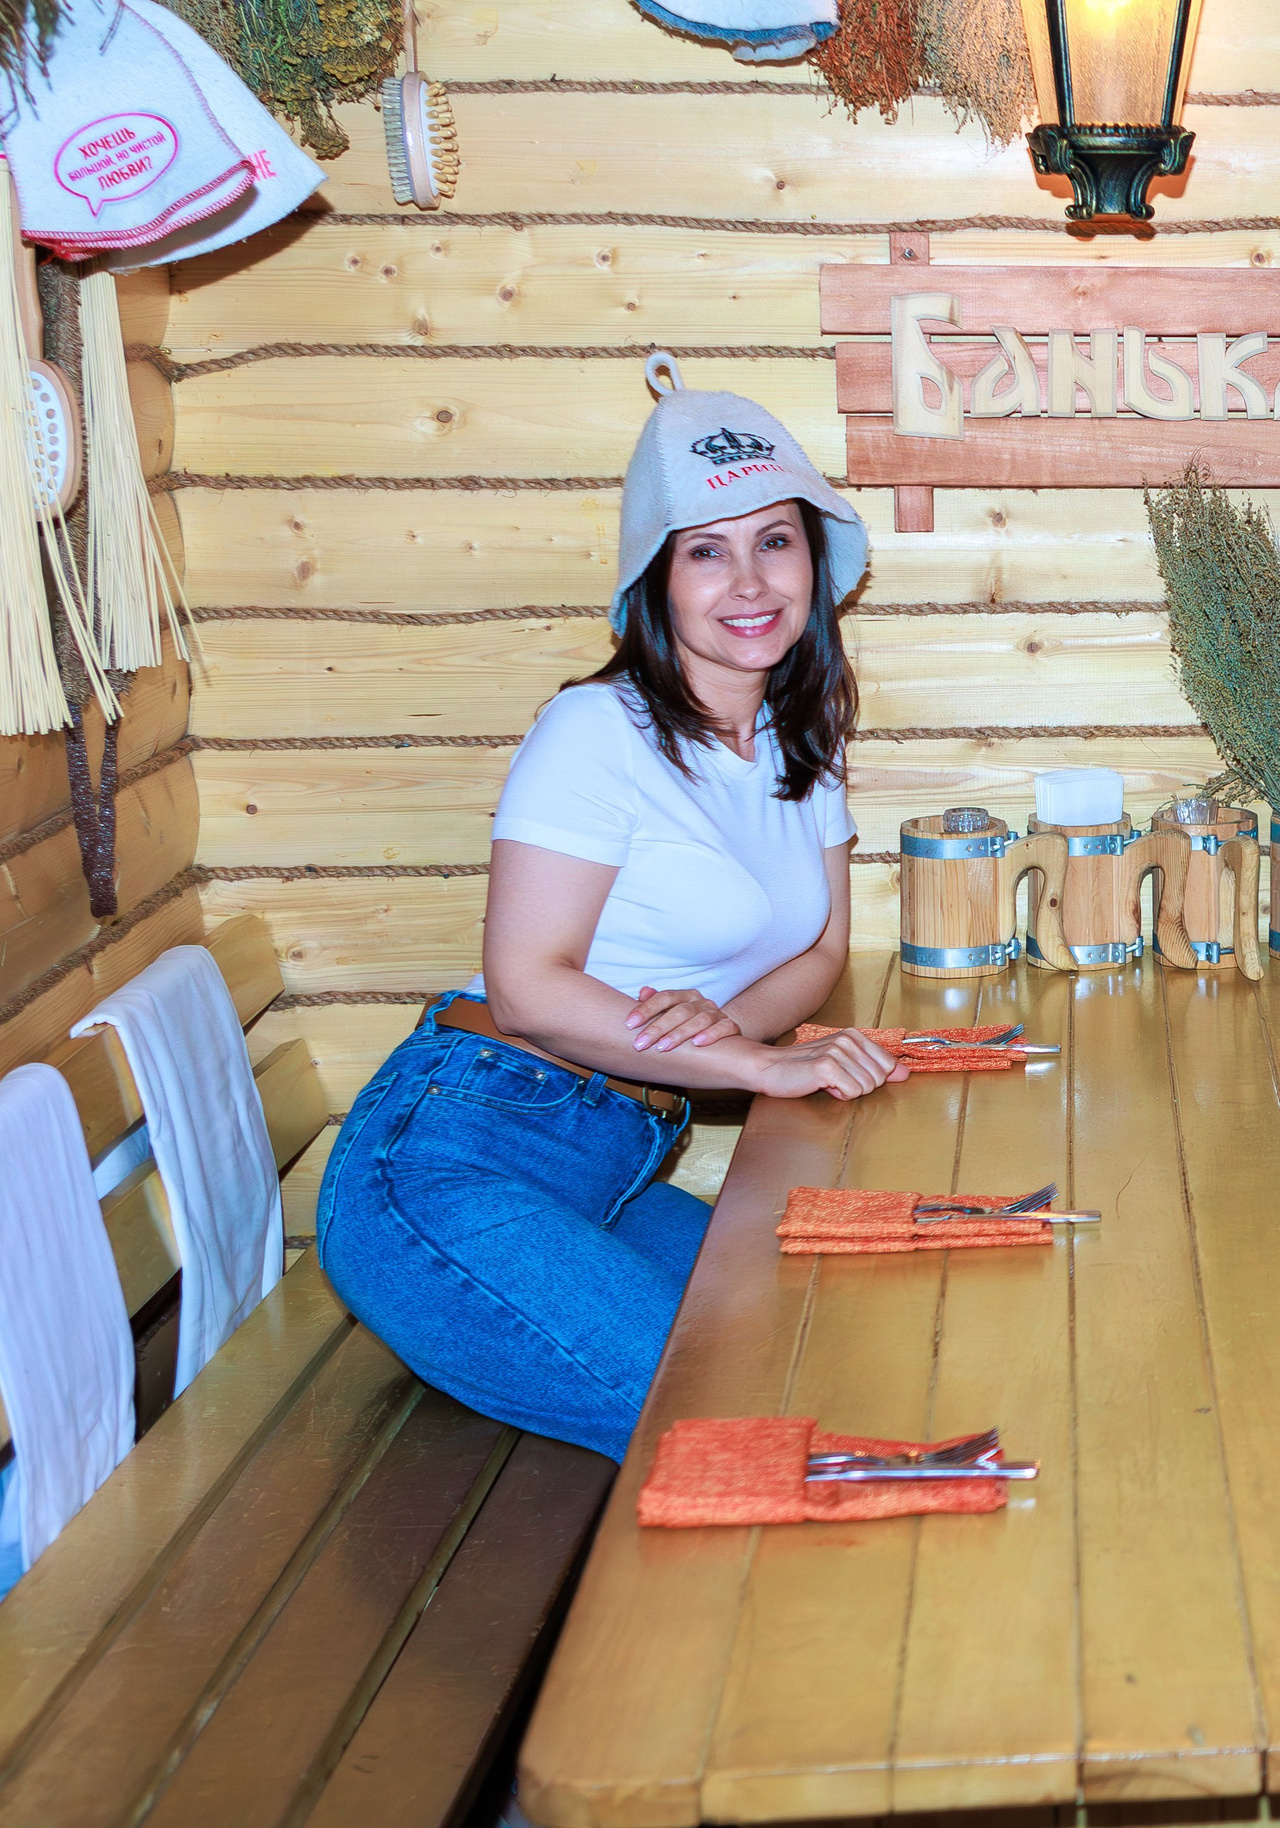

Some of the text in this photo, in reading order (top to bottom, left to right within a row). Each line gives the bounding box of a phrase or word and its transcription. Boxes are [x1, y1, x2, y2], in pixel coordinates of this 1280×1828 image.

[67, 131, 167, 182] БОЛЬШОЙ, НО ЧИСТОЙ
[78, 127, 136, 160] ХОЧЕШЬ
[97, 155, 153, 191] ЛЮБВИ?
